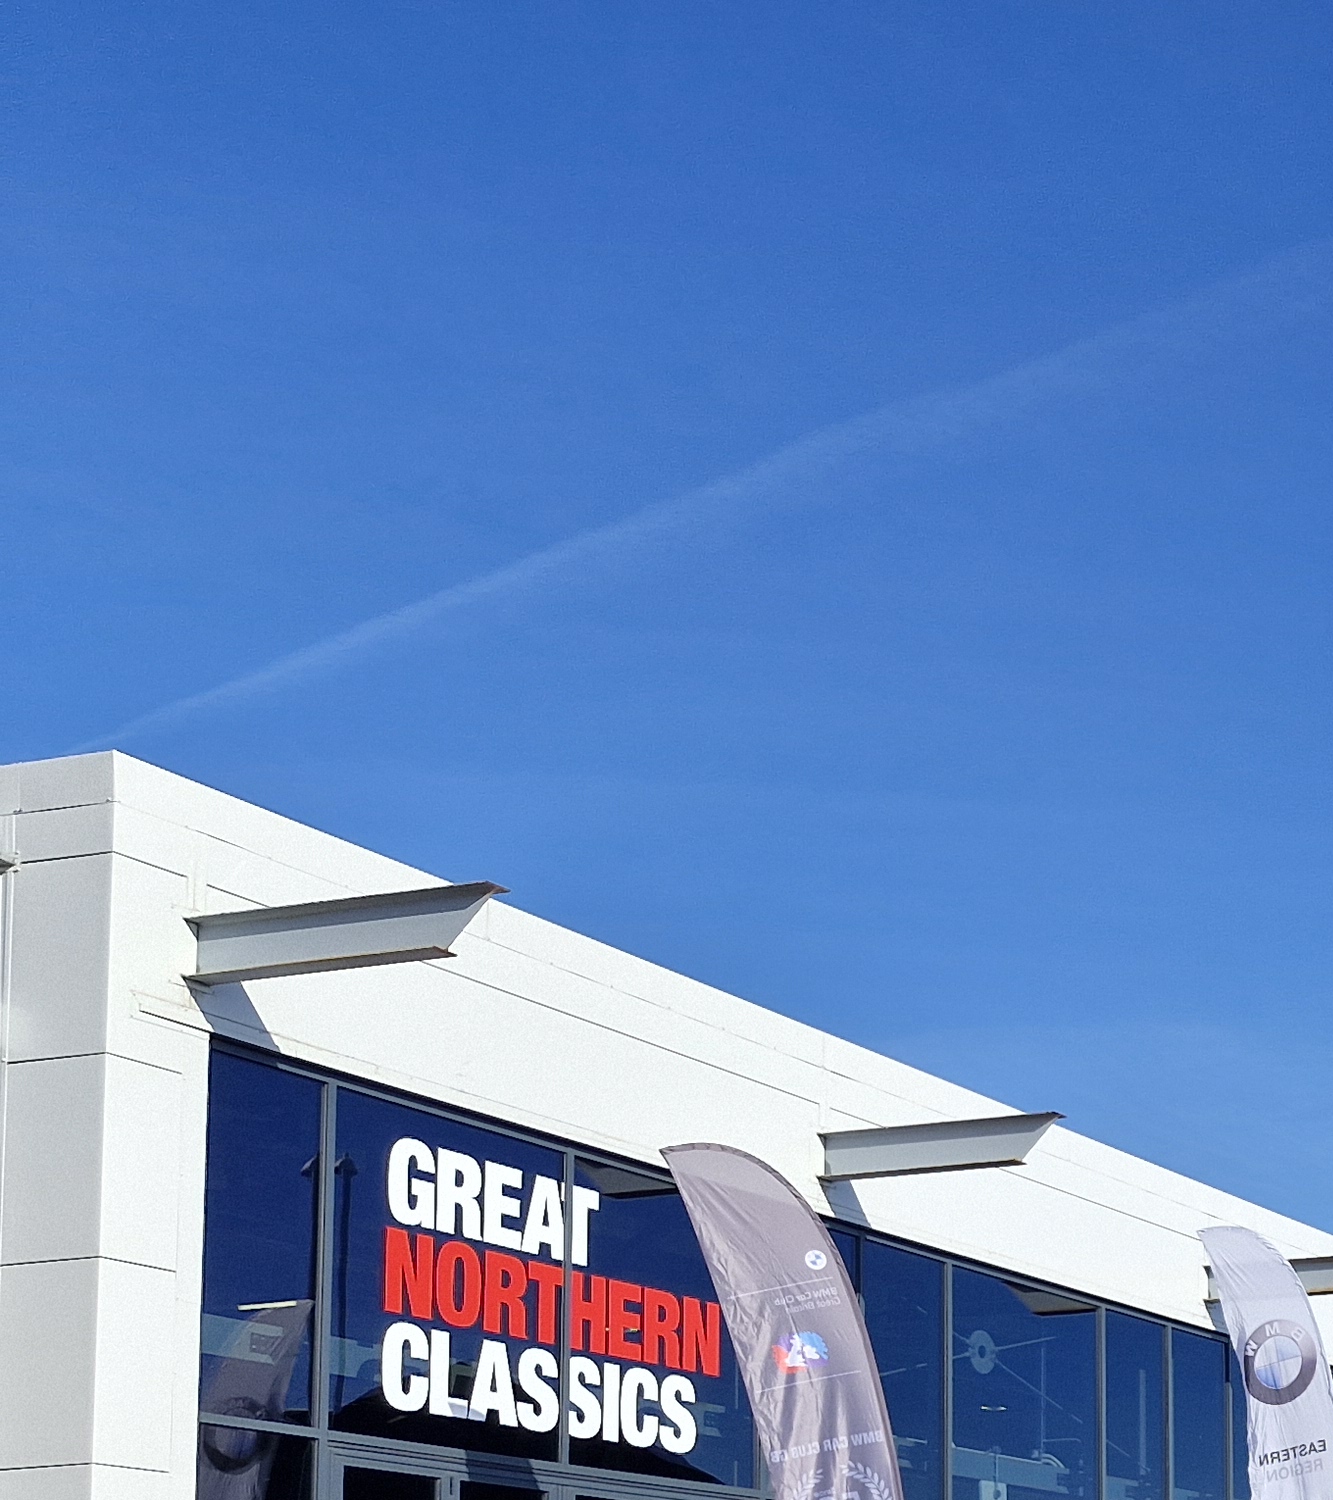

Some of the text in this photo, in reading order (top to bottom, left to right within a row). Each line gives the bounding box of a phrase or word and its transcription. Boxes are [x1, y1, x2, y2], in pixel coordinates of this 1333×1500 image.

[386, 1137, 600, 1267] GREAT
[382, 1226, 721, 1378] NORTHERN
[381, 1321, 697, 1456] CLASSICS
